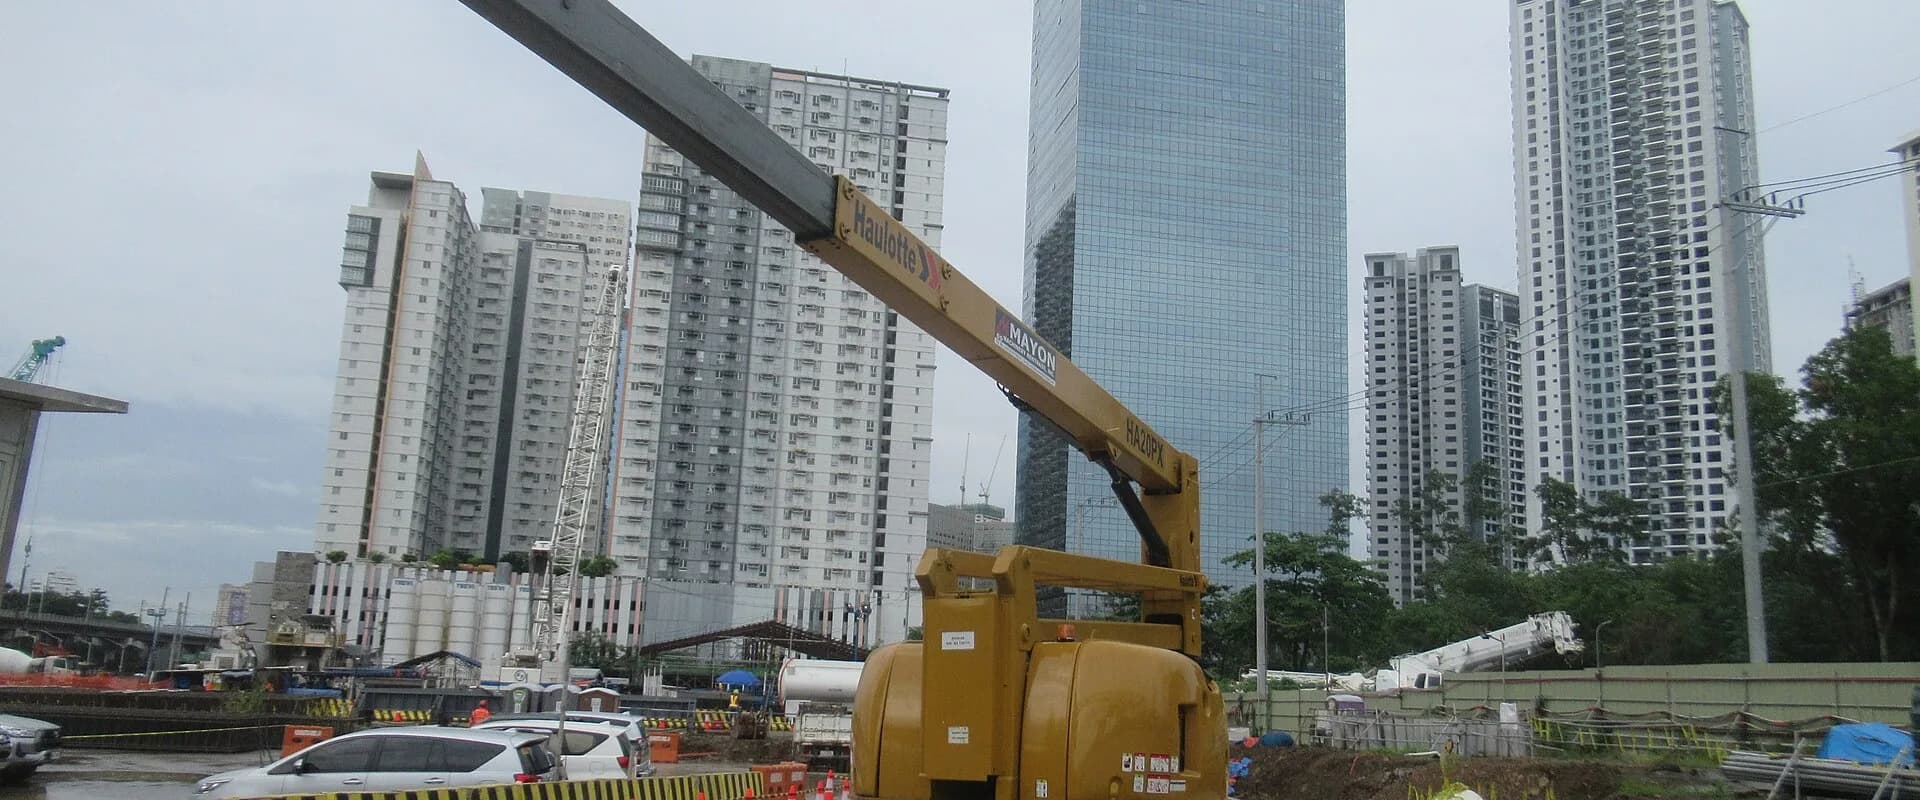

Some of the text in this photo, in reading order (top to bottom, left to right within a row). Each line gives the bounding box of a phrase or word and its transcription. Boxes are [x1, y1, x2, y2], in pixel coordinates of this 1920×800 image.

[854, 199, 916, 274] Haulotte
[1009, 322, 1056, 371] MAYON
[1126, 417, 1164, 468] HA20PX
